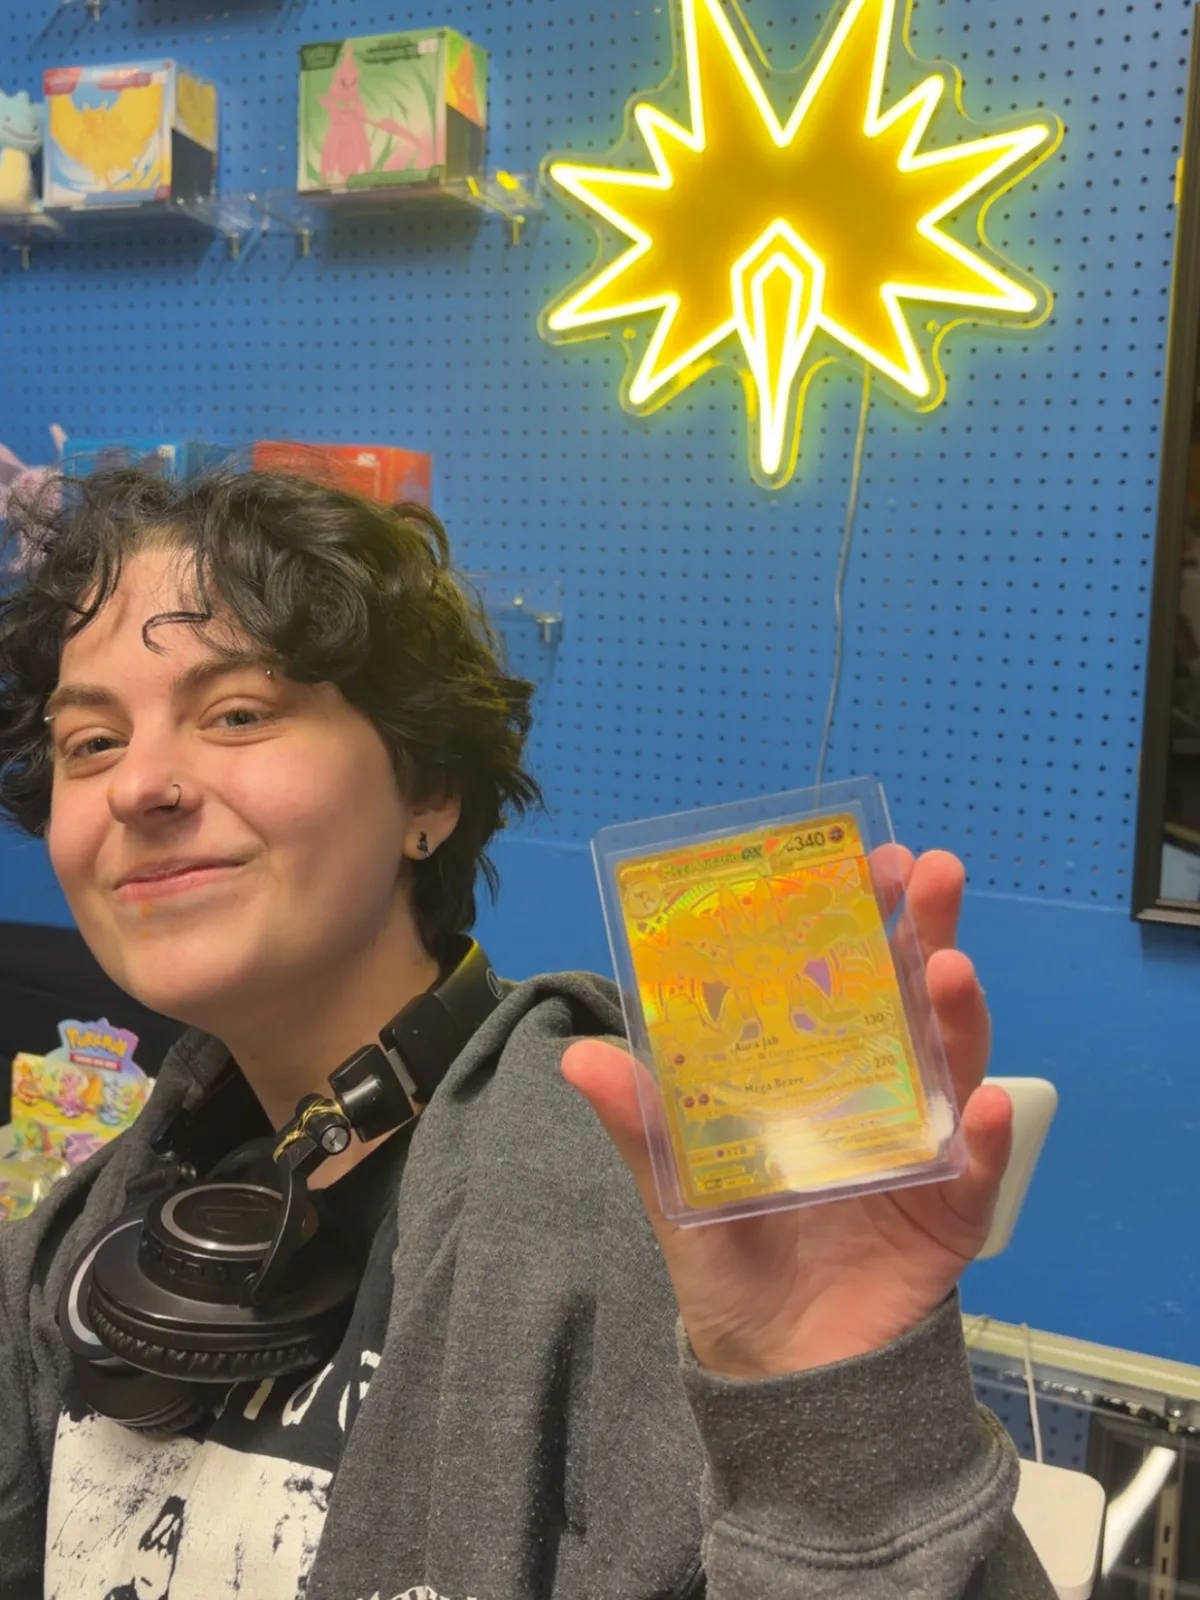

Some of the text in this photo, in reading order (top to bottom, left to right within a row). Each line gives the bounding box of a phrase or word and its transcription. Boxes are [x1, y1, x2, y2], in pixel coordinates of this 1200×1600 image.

[794, 831, 826, 852] 340
[762, 1034, 780, 1050] Jab
[743, 1081, 773, 1095] Mega
[774, 1075, 805, 1089] Brave
